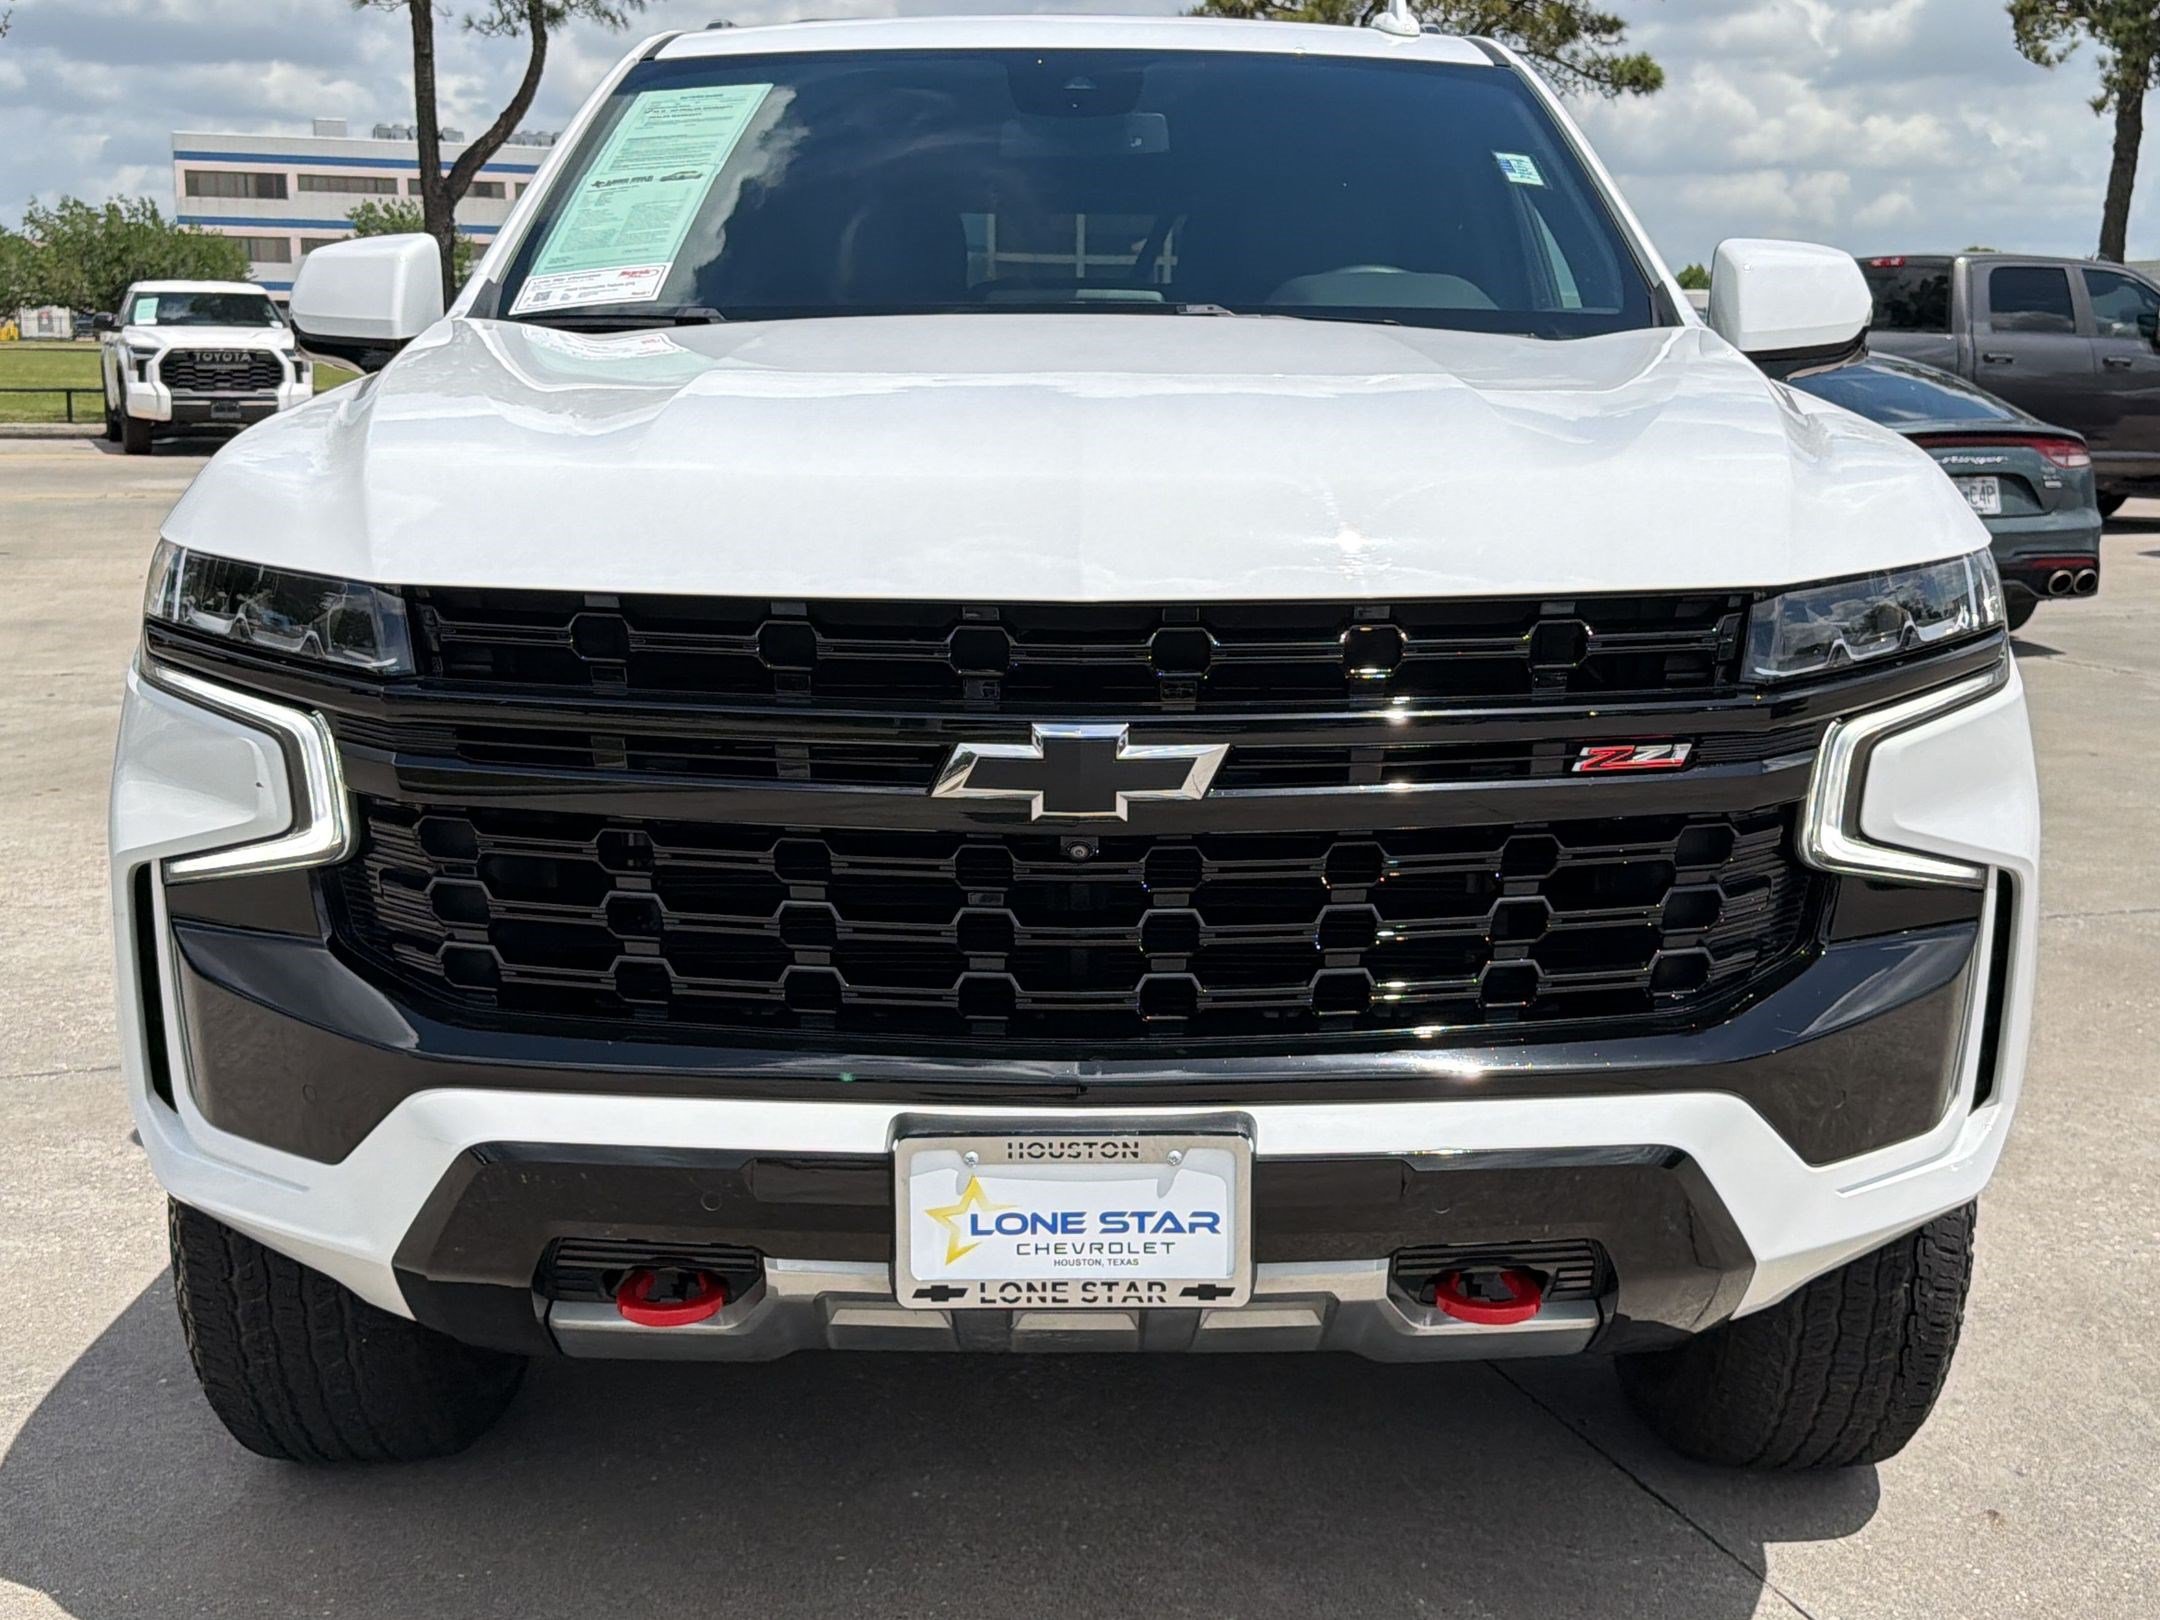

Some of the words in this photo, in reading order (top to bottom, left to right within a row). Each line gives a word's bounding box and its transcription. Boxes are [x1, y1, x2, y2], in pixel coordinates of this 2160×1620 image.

[193, 352, 252, 362] TOYOTA
[1007, 1141, 1139, 1160] HOUSTON
[970, 1210, 1087, 1236] LONE
[1099, 1210, 1221, 1235] STAR
[1016, 1241, 1176, 1256] CHEVROLET
[1053, 1257, 1104, 1268] HOUSTON,
[1107, 1257, 1139, 1267] TEXAS
[979, 1281, 1069, 1304] LONE
[1081, 1281, 1167, 1304] STAR
